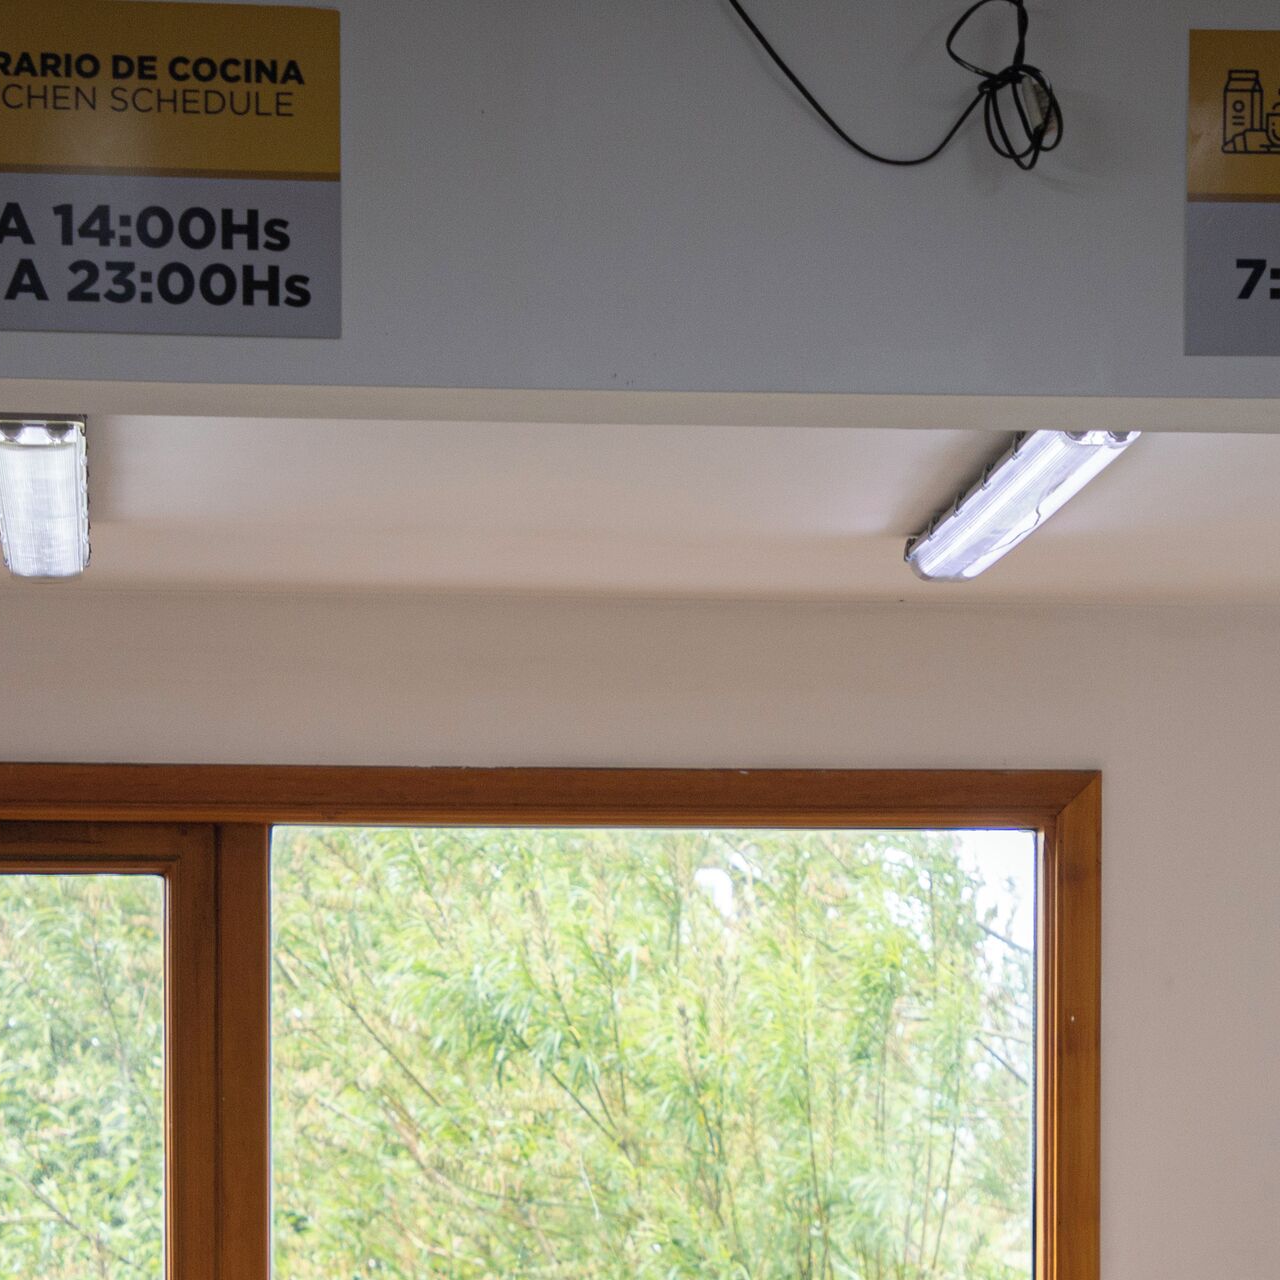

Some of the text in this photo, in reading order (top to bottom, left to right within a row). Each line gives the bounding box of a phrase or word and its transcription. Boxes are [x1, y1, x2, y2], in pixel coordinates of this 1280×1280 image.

[112, 55, 157, 80] DE
[168, 56, 305, 85] COCINA
[111, 87, 294, 117] SCHEDULE
[53, 204, 290, 252] 14:00Hs
[4, 259, 49, 300] A
[68, 260, 311, 307] 23:00Hs
